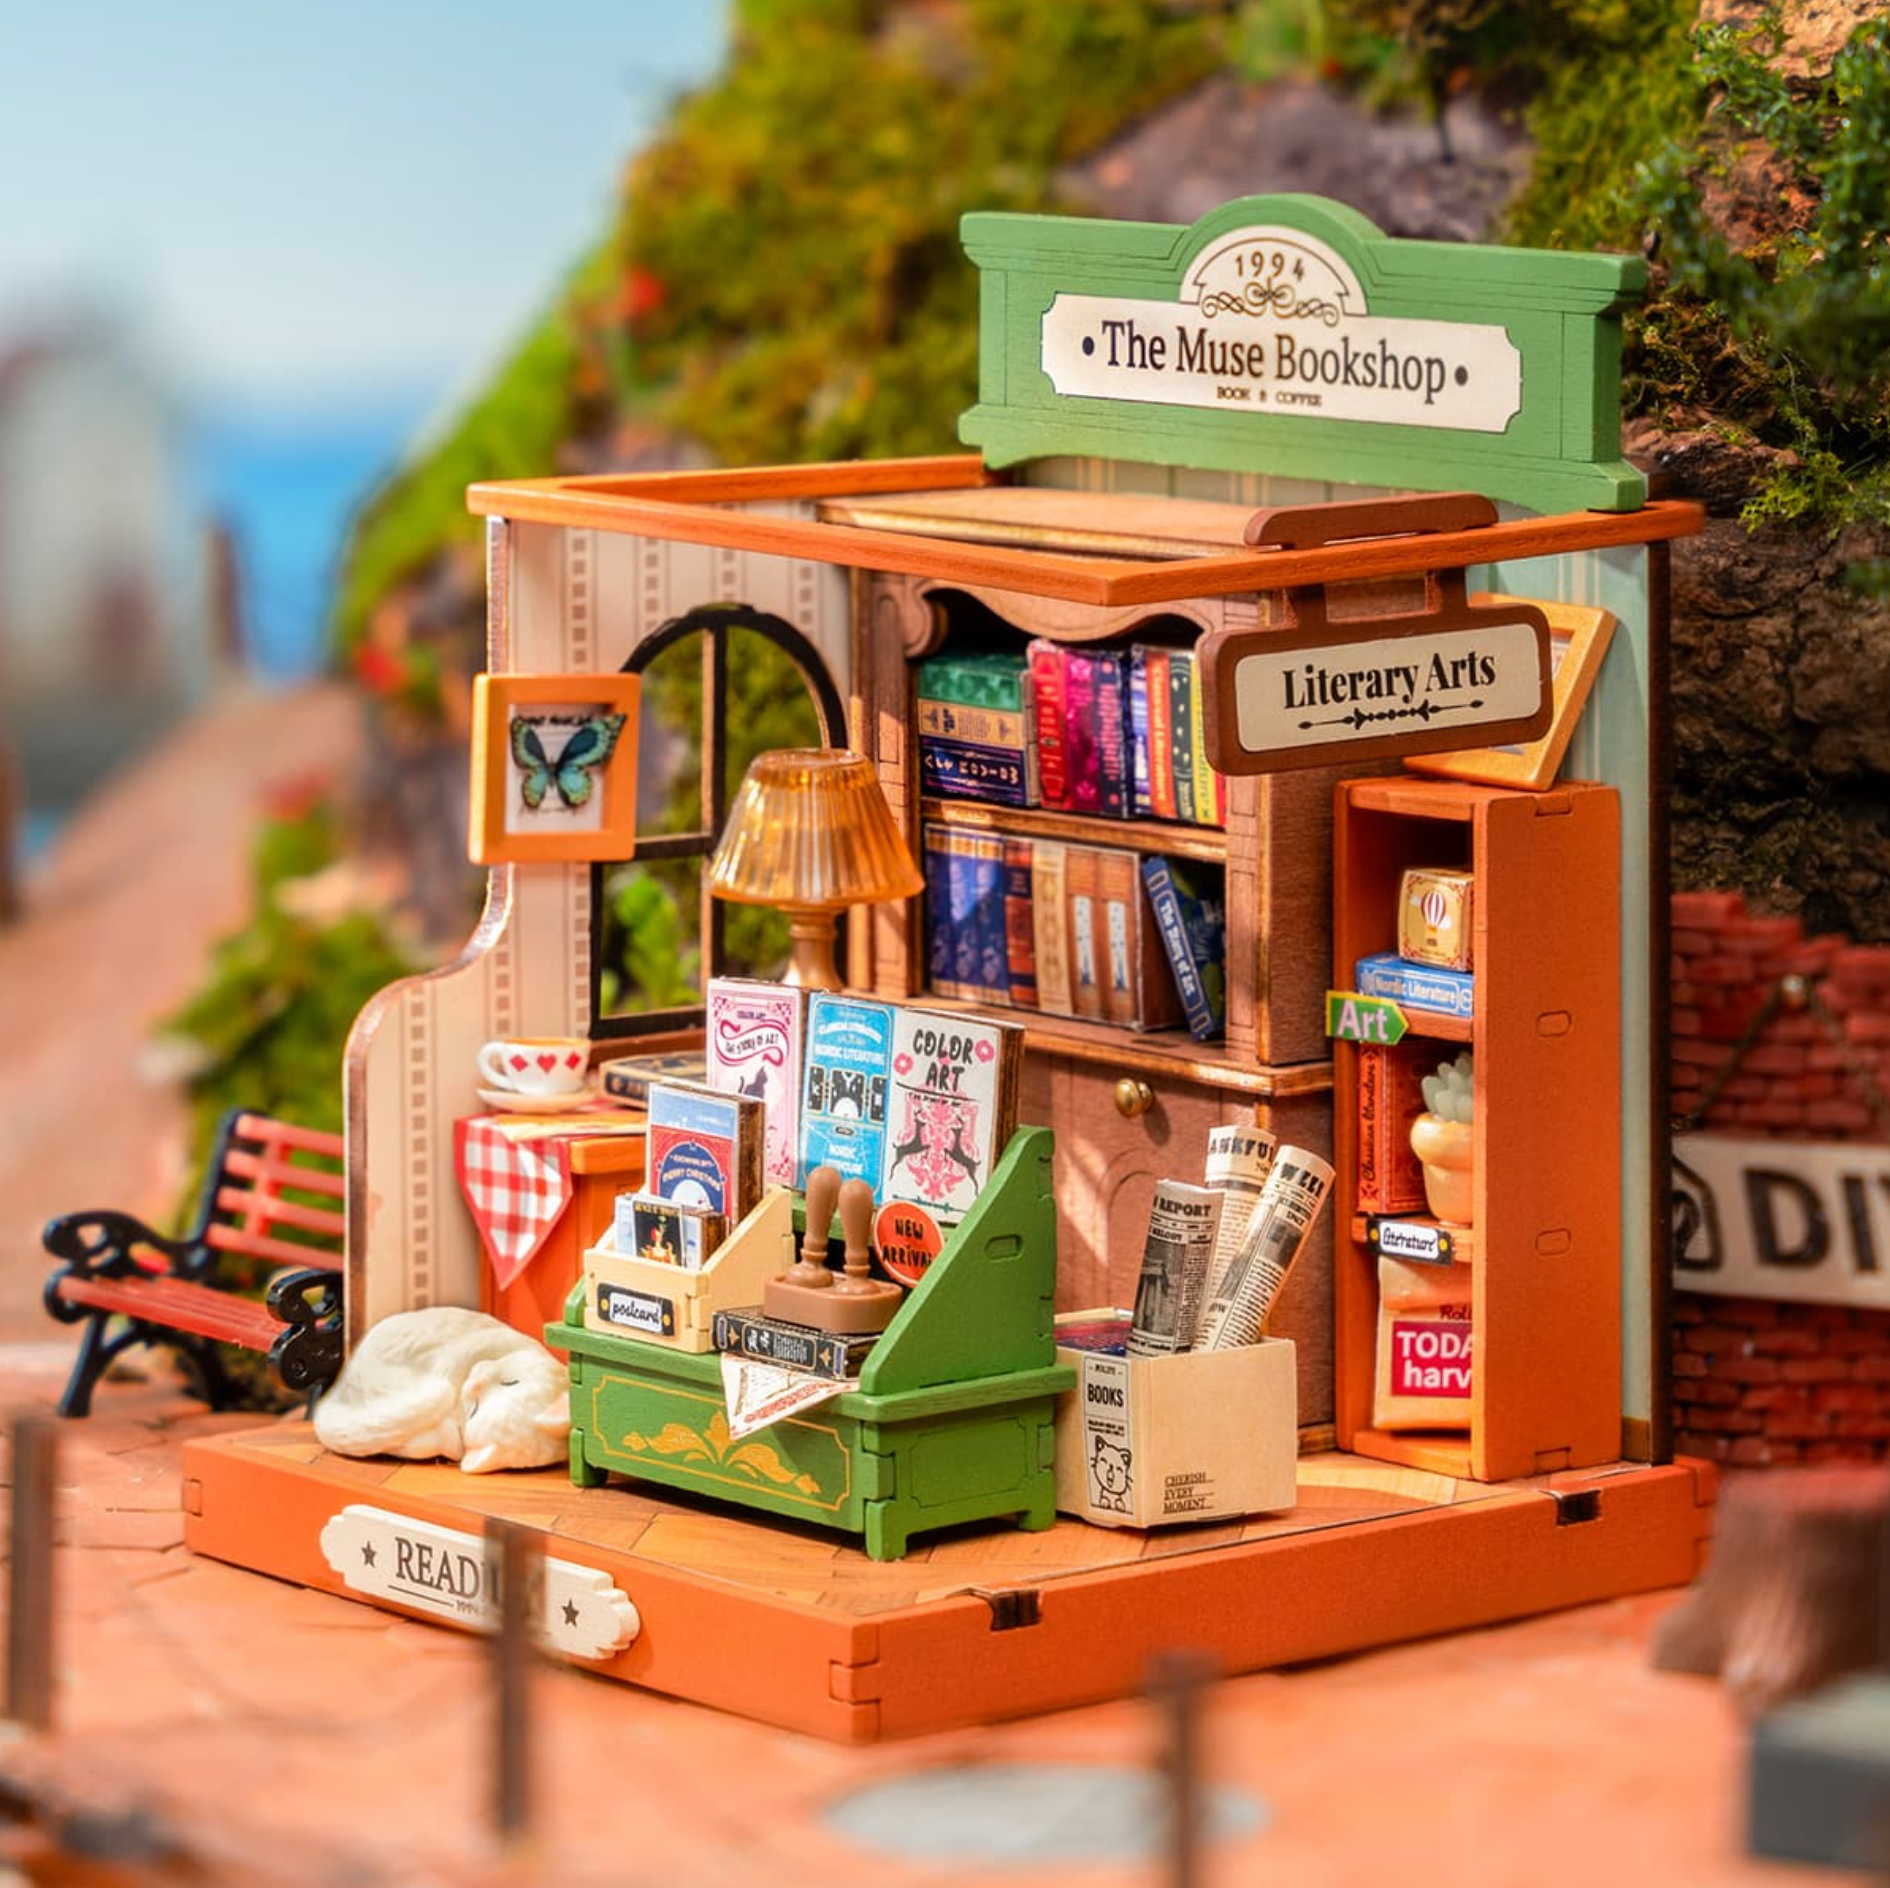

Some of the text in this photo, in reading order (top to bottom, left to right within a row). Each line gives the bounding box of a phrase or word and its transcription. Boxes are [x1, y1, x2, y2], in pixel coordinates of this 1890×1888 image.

[1235, 250, 1306, 282] 1994
[1102, 319, 1446, 404] The Muse Bookshop
[1217, 386, 1250, 401] BOOK
[1282, 650, 1496, 710] Literary Arts
[1337, 1000, 1389, 1042] Art
[913, 1028, 974, 1065] COLOR
[926, 1062, 966, 1092] ART
[1159, 1198, 1212, 1218] REPORT
[894, 1218, 923, 1240] NEW
[612, 1300, 660, 1325] postcard
[1088, 1383, 1125, 1408] BOOKS
